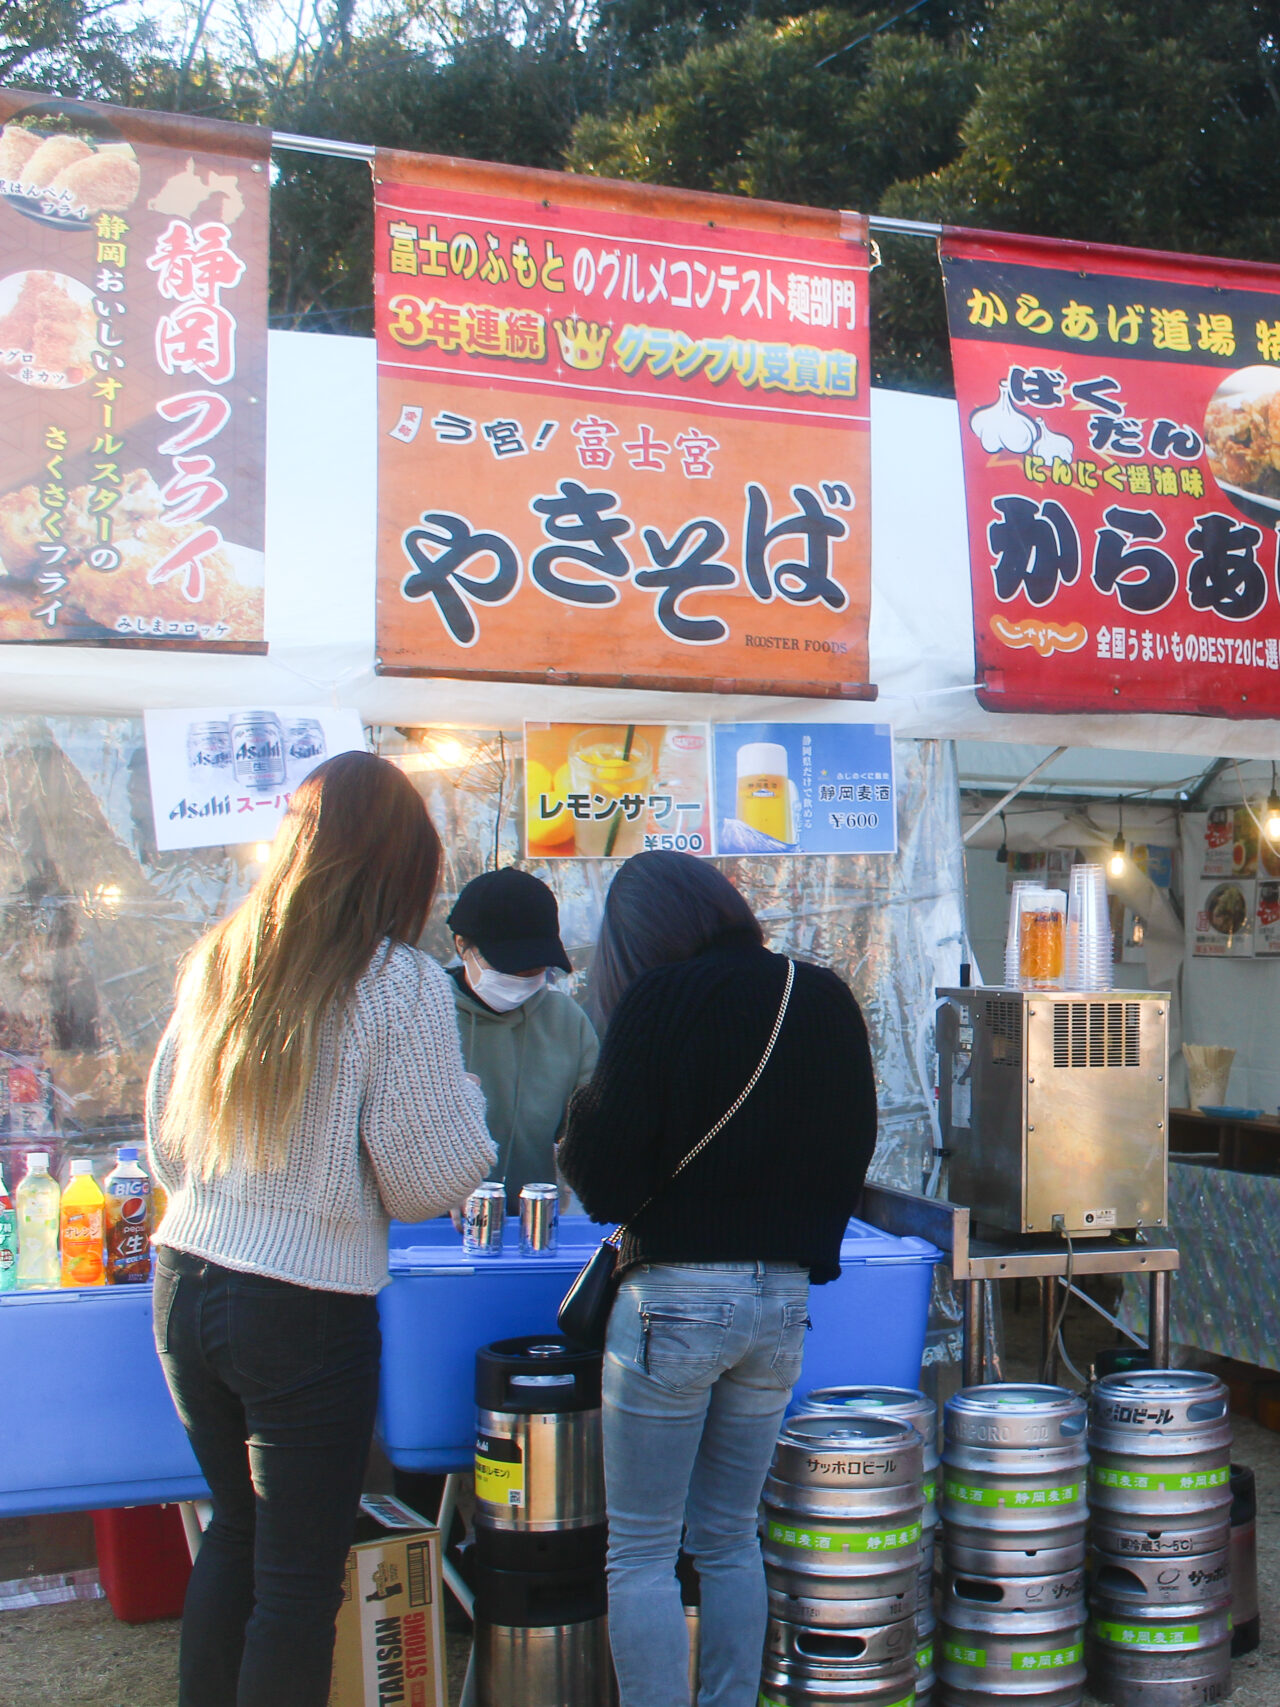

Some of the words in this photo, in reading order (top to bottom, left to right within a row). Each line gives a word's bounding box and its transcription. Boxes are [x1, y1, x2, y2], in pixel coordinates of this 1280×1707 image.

[42, 202, 88, 219] フライ
[967, 288, 1236, 357] からあげ道場
[0, 350, 34, 362] グロ
[387, 293, 548, 362] 3年連続
[614, 324, 859, 398] グランプリ受賞店
[90, 213, 130, 572] 静岡おいしいオールスターの
[571, 414, 720, 479] 富士宮
[1024, 454, 1205, 499] にんにく醤油味
[34, 425, 69, 628] さくさくフライ
[401, 479, 856, 648] やきそば
[117, 618, 228, 636] みしまコロッケ
[745, 635, 800, 651] ROOSTER
[804, 640, 848, 654] FOODS
[819, 784, 890, 801] 静岡麦酒
[169, 794, 231, 821] Asahi
[539, 793, 701, 822] レモンサワー
[829, 812, 879, 829] ¥600
[644, 834, 703, 852] ¥500
[1014, 1488, 1073, 1504] 静岡麦酒
[404, 1611, 428, 1680] STRONG
[1121, 1630, 1185, 1643] 静岡麦酒
